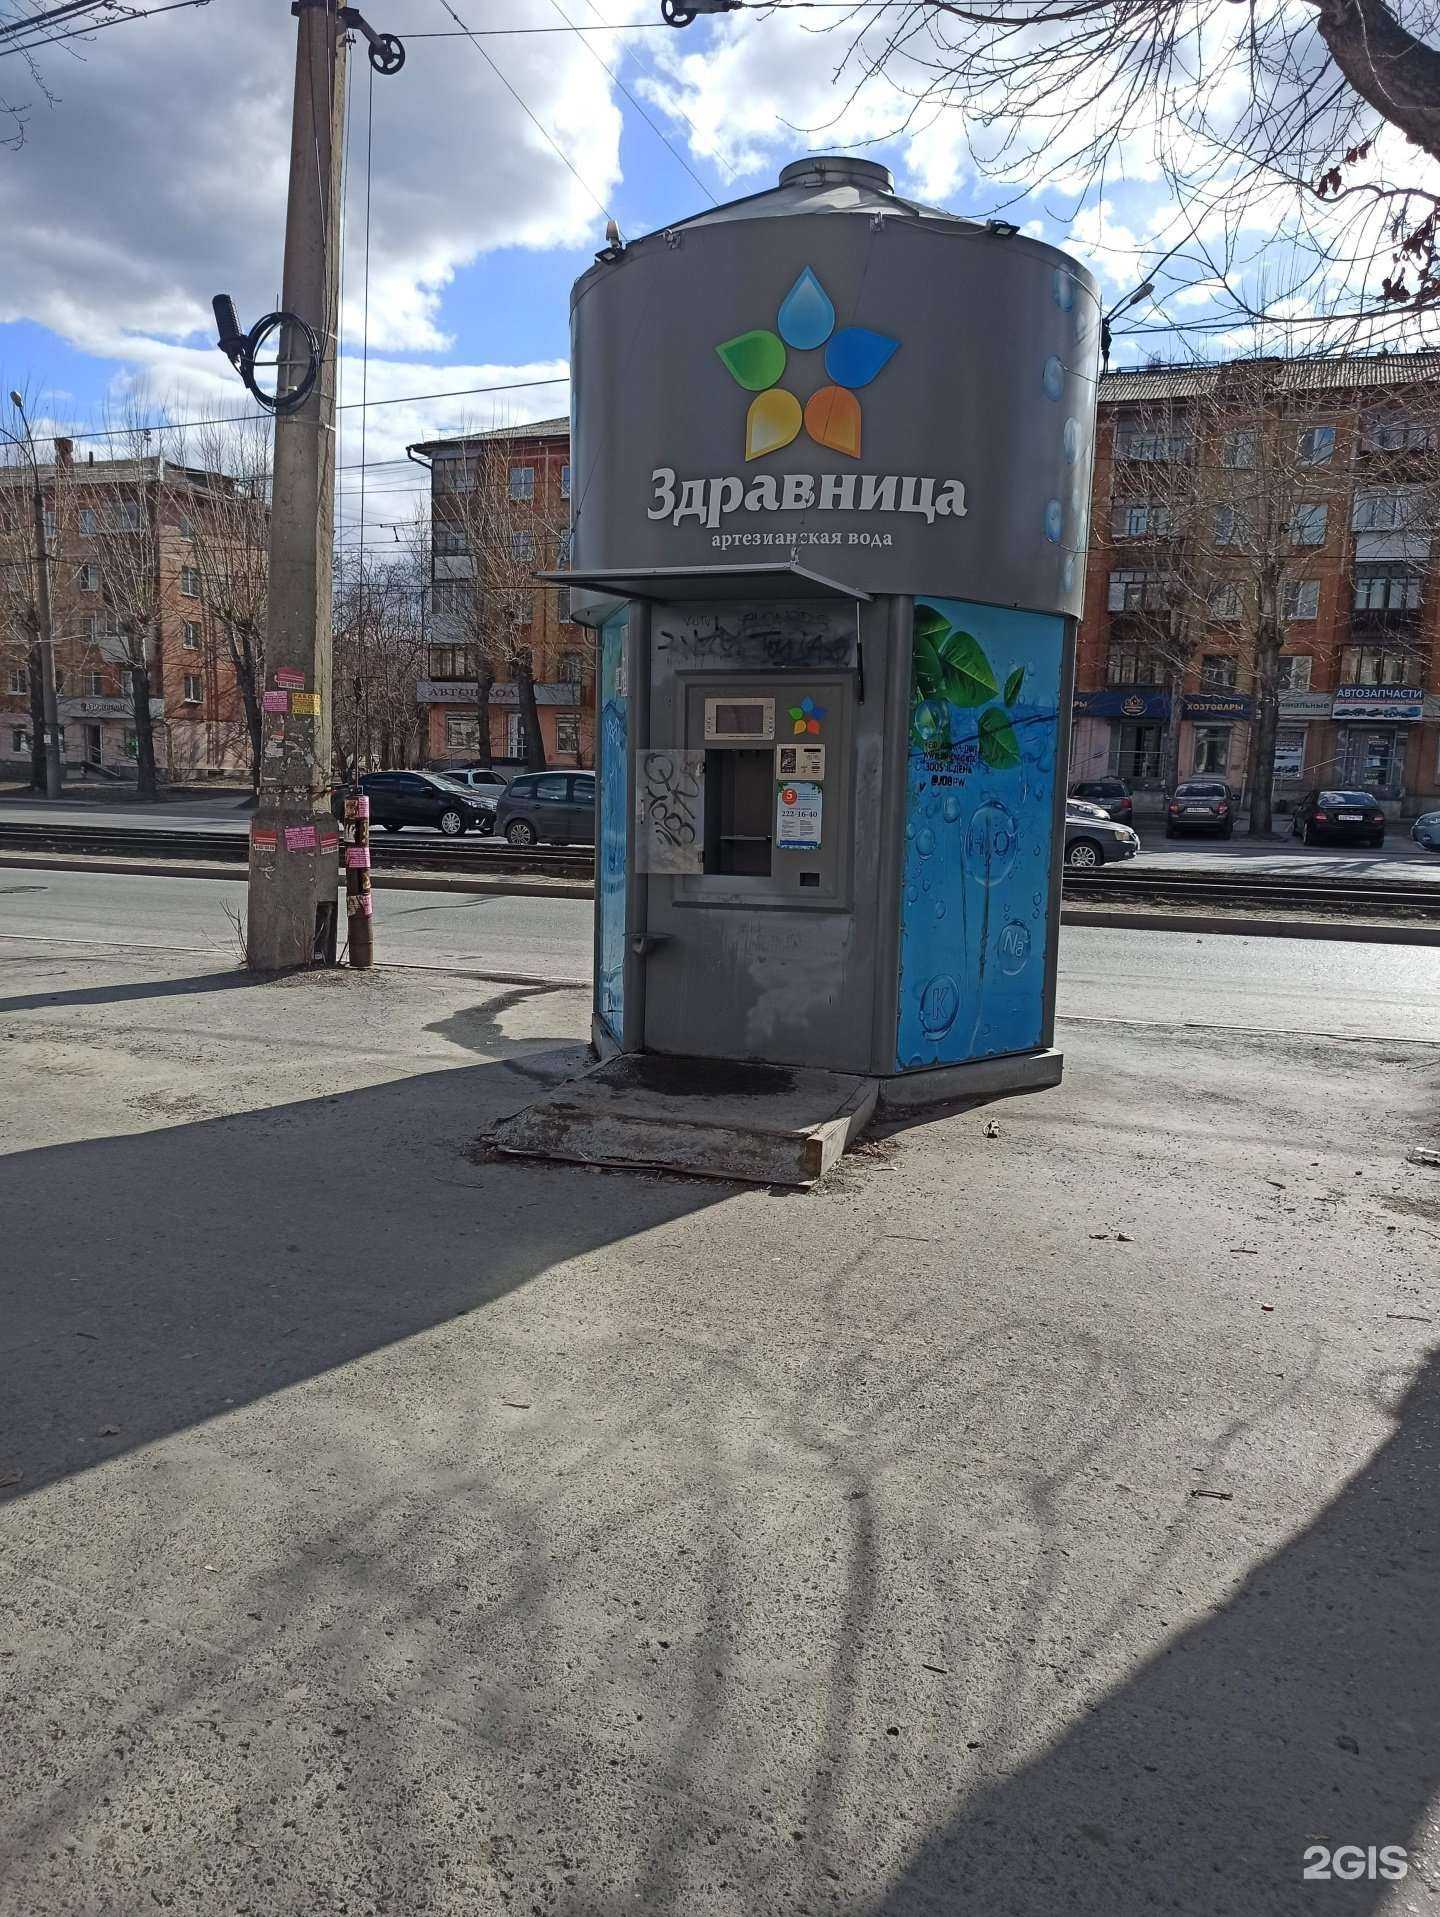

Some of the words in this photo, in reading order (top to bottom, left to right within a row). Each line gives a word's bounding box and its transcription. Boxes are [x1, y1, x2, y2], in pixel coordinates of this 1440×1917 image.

[647, 467, 969, 529] Здравница
[711, 530, 843, 550] артезианская
[848, 532, 893, 547] вода
[1336, 688, 1422, 698] АВТОЗАПЧАСТИ
[1187, 703, 1244, 711] ХОЗТОВАРЫ
[1003, 930, 1024, 957] Na
